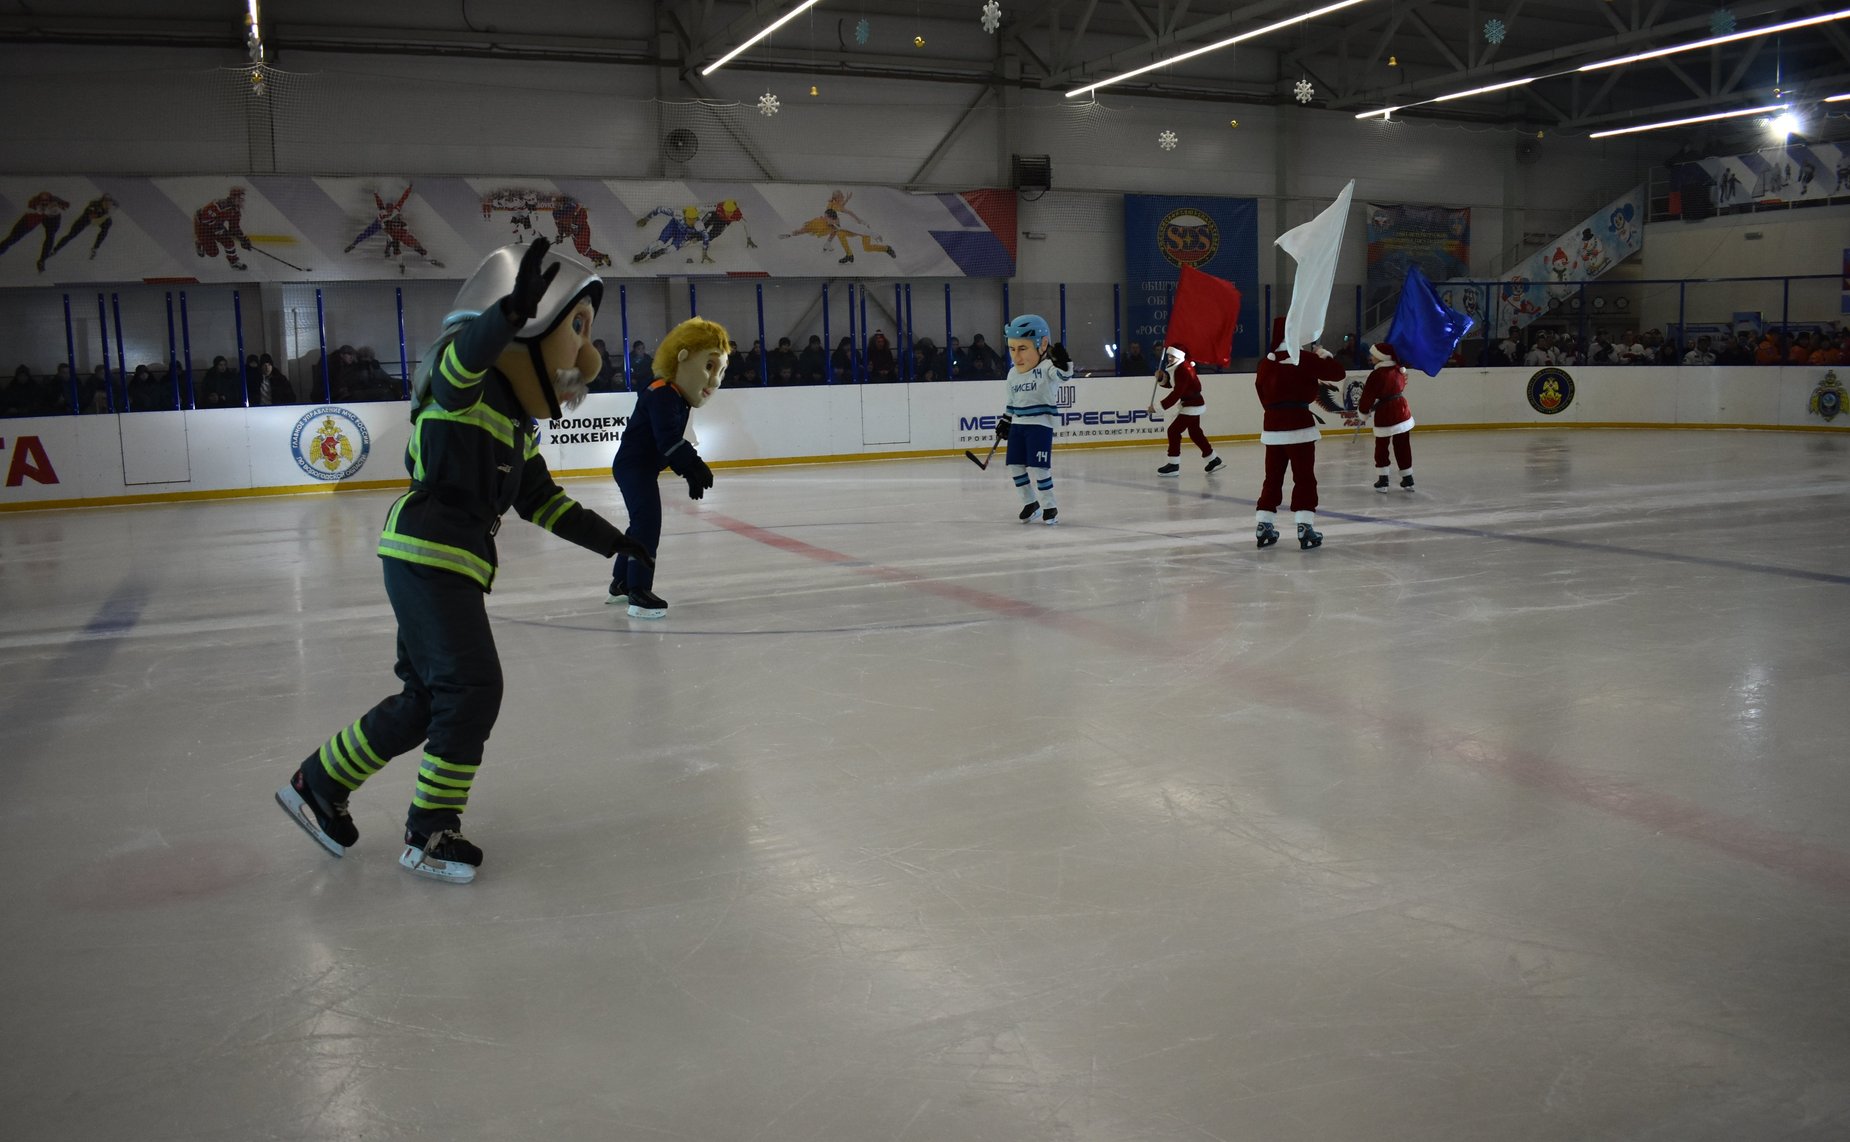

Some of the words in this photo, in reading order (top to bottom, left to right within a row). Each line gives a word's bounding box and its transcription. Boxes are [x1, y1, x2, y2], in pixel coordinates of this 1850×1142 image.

[1032, 368, 1043, 379] 14
[341, 409, 355, 420] МЧС
[549, 416, 631, 430] МОЛОДЕЖ
[1036, 450, 1049, 463] 14
